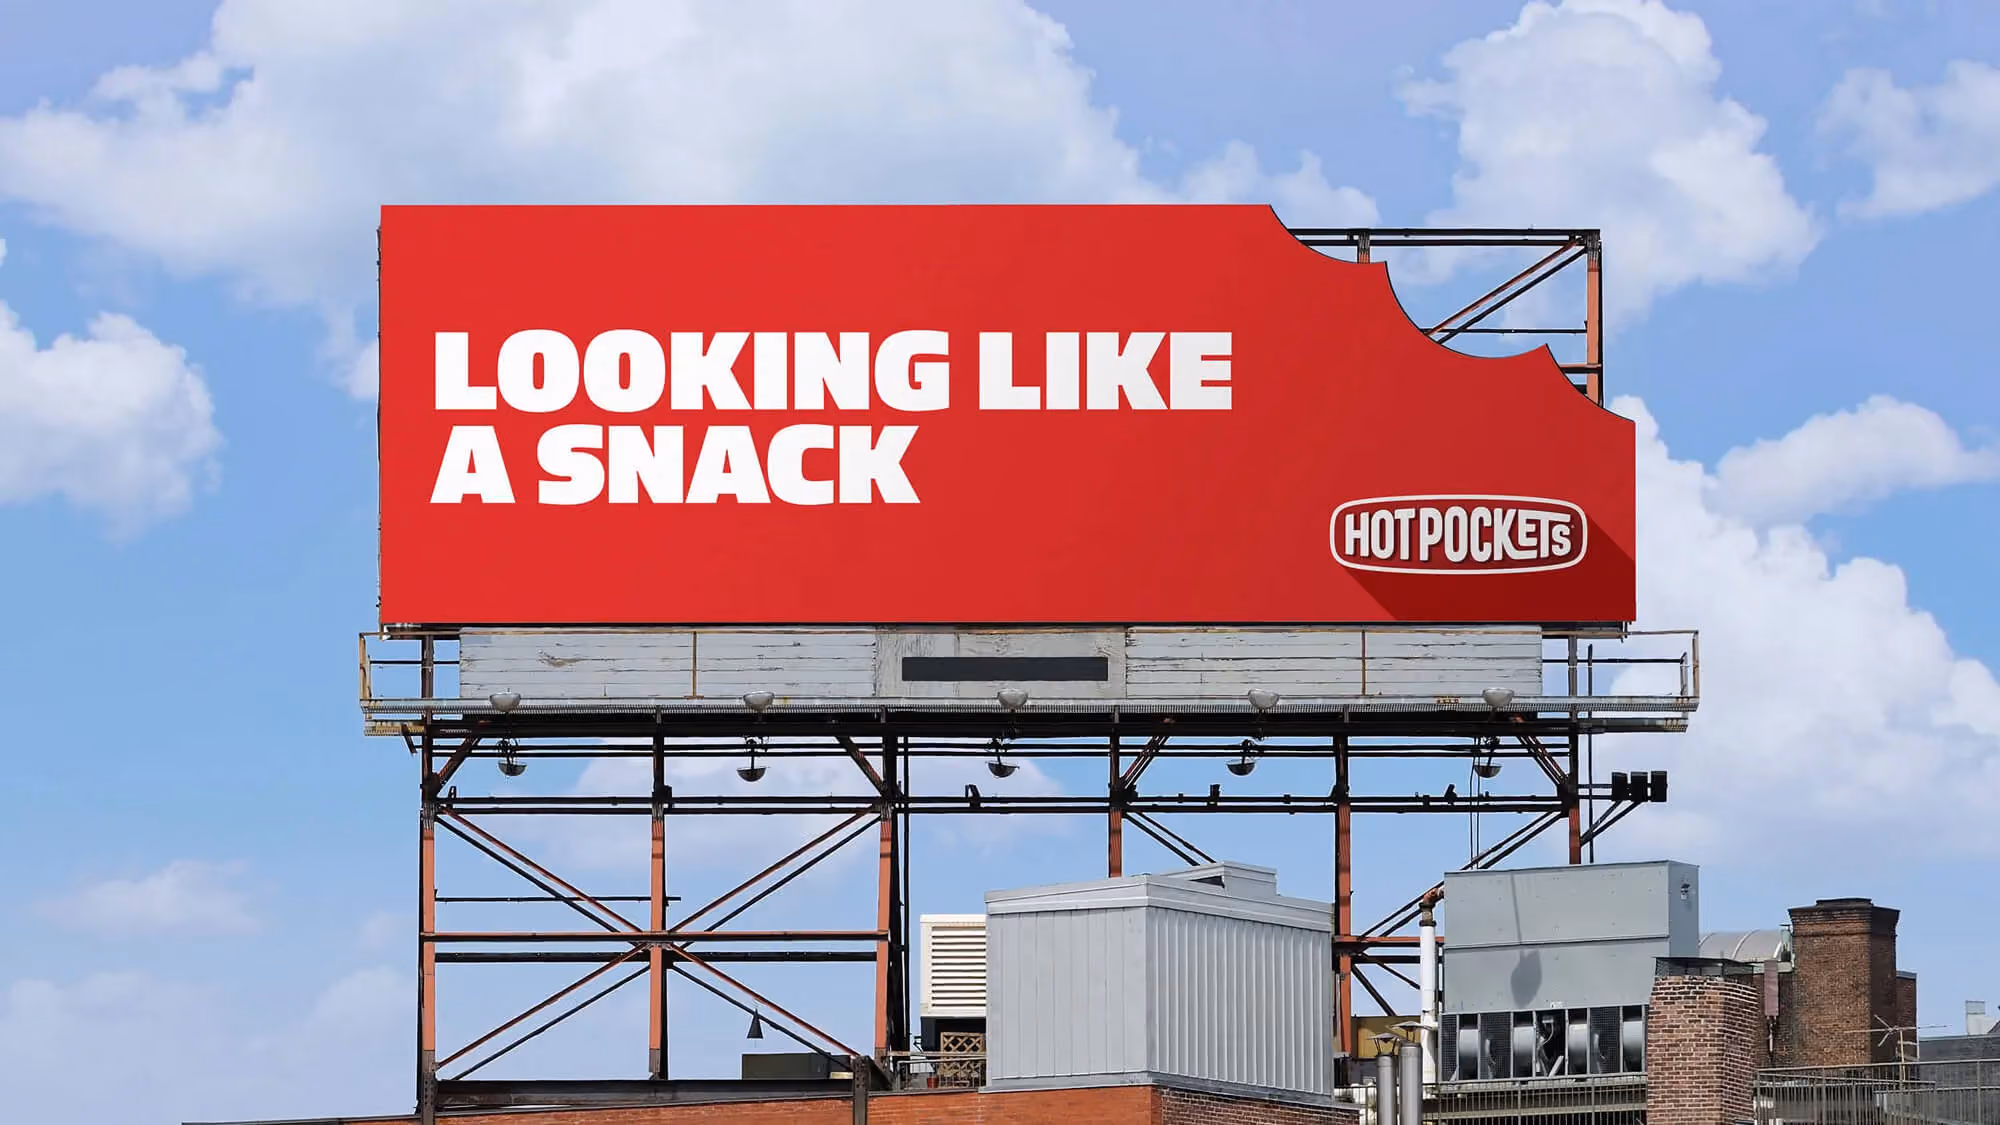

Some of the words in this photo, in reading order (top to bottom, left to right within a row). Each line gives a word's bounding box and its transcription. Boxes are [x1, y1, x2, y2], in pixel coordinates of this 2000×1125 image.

[434, 329, 950, 412] LOOKING
[978, 331, 1233, 410] LIKE
[430, 425, 515, 504] A
[537, 423, 921, 505] SNACK
[1345, 507, 1416, 560] HOT
[1419, 506, 1572, 563] POCKETS
